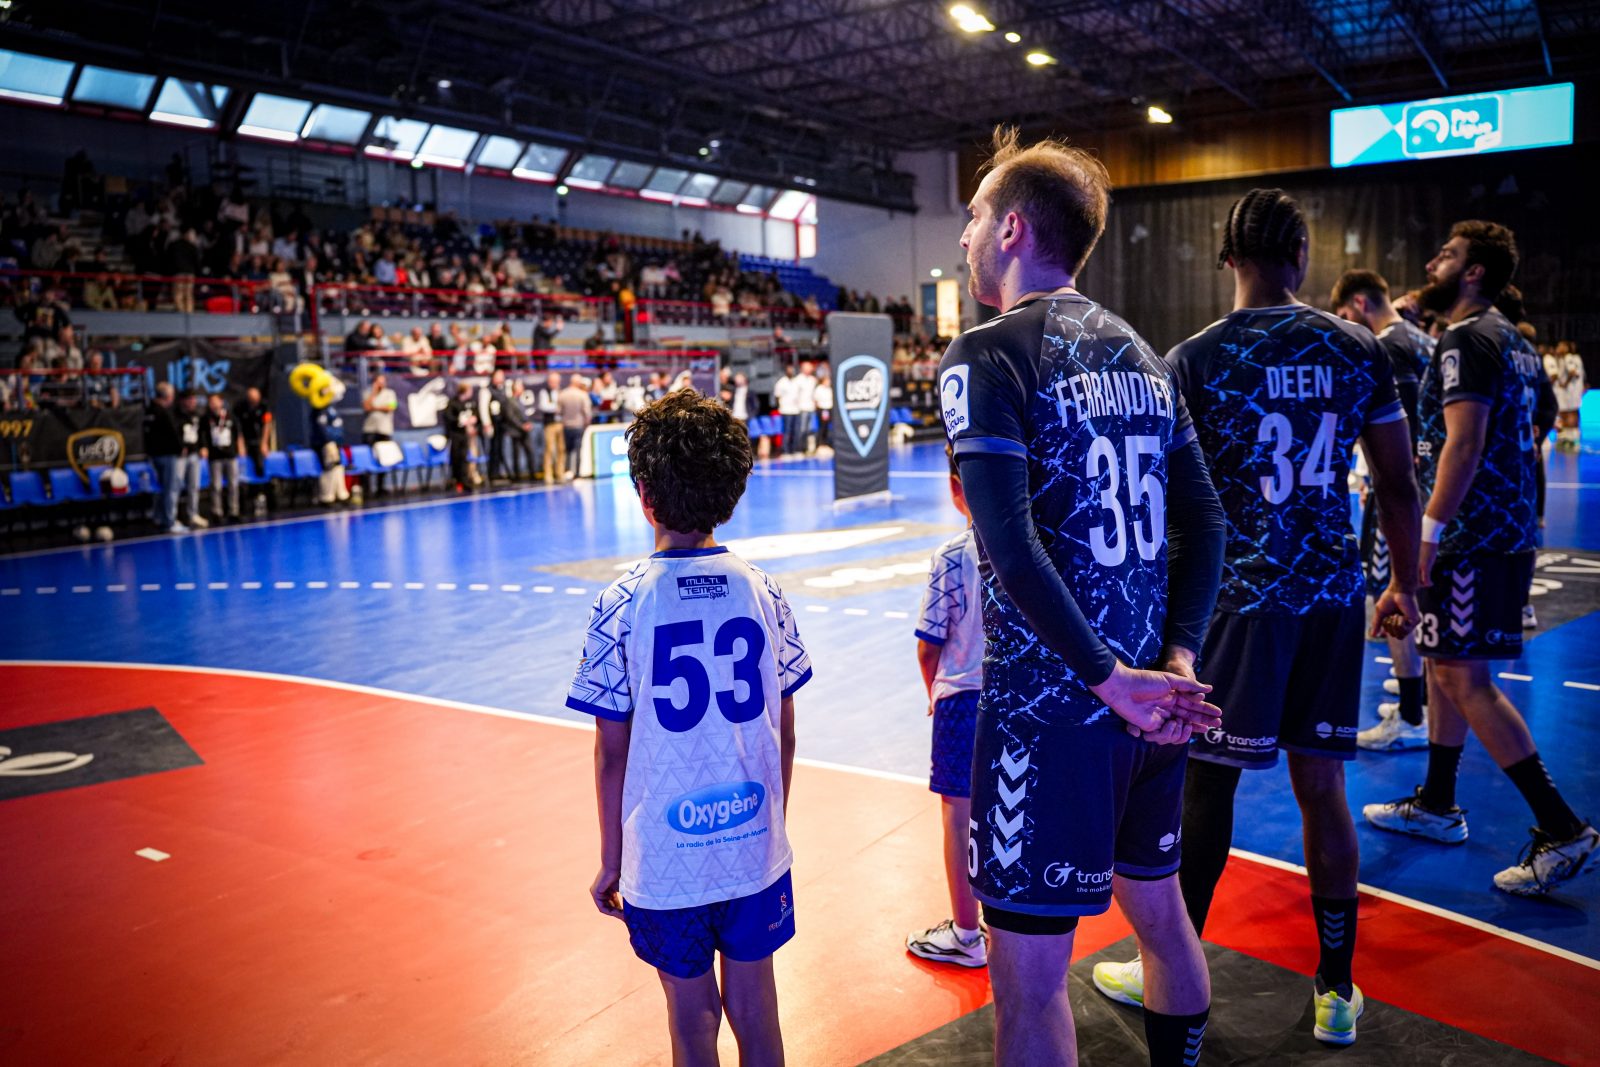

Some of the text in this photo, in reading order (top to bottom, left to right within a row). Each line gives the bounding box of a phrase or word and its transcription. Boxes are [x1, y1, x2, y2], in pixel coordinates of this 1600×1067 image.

[1055, 371, 1173, 428] FERRANDIER
[1265, 365, 1333, 400] DEEN
[1258, 412, 1338, 505] 34
[1086, 435, 1166, 568] 35
[684, 585, 723, 595] TEMPO
[685, 577, 720, 586] MULTI
[652, 616, 766, 733] 53
[679, 792, 759, 829] Oxygène
